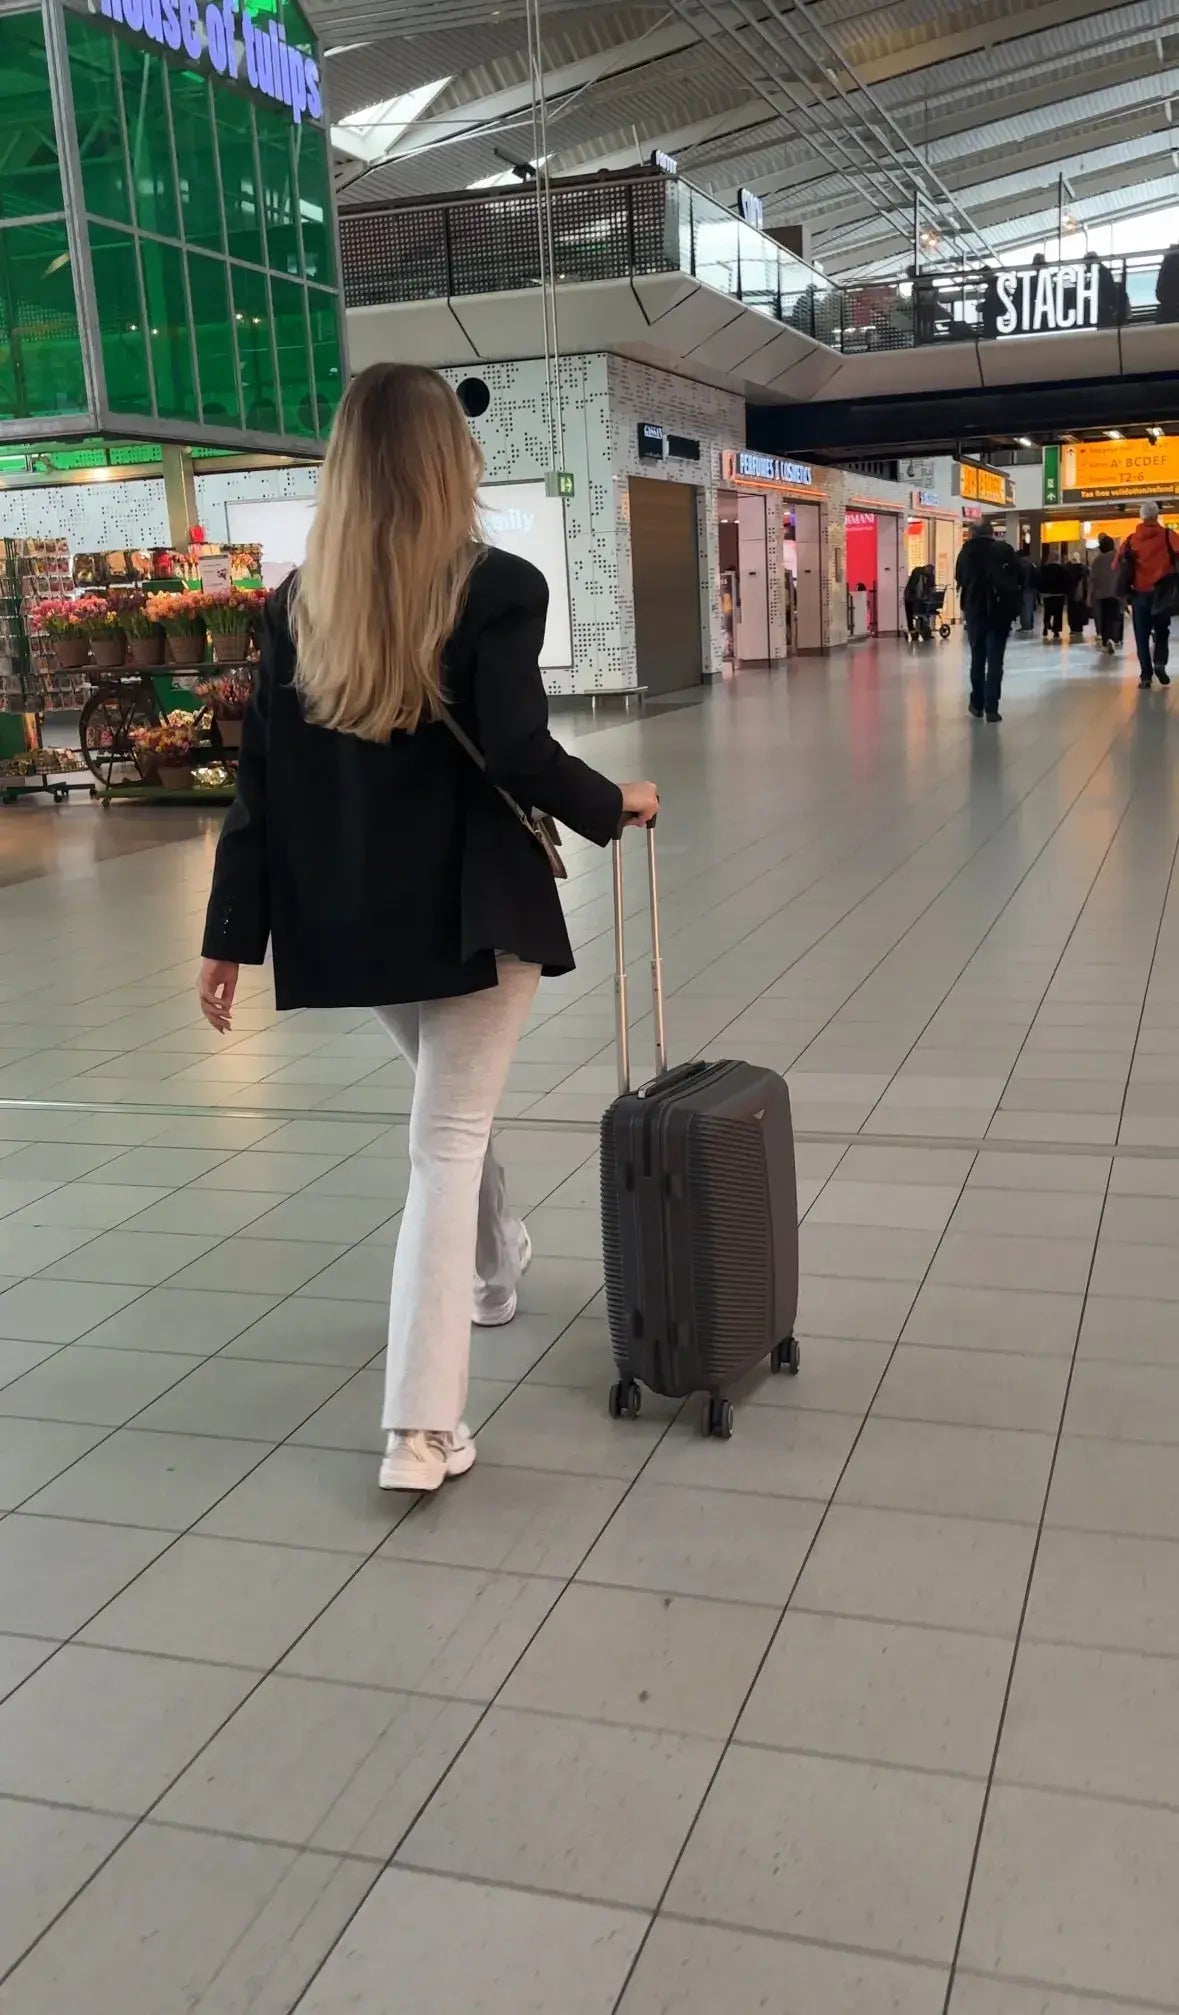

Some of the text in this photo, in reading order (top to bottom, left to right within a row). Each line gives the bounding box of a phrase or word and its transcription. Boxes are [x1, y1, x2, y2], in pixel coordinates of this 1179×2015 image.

[205, 0, 239, 79] of
[242, 9, 322, 124] tulips
[996, 263, 1099, 334] STACH
[740, 453, 774, 479] PERFUMES
